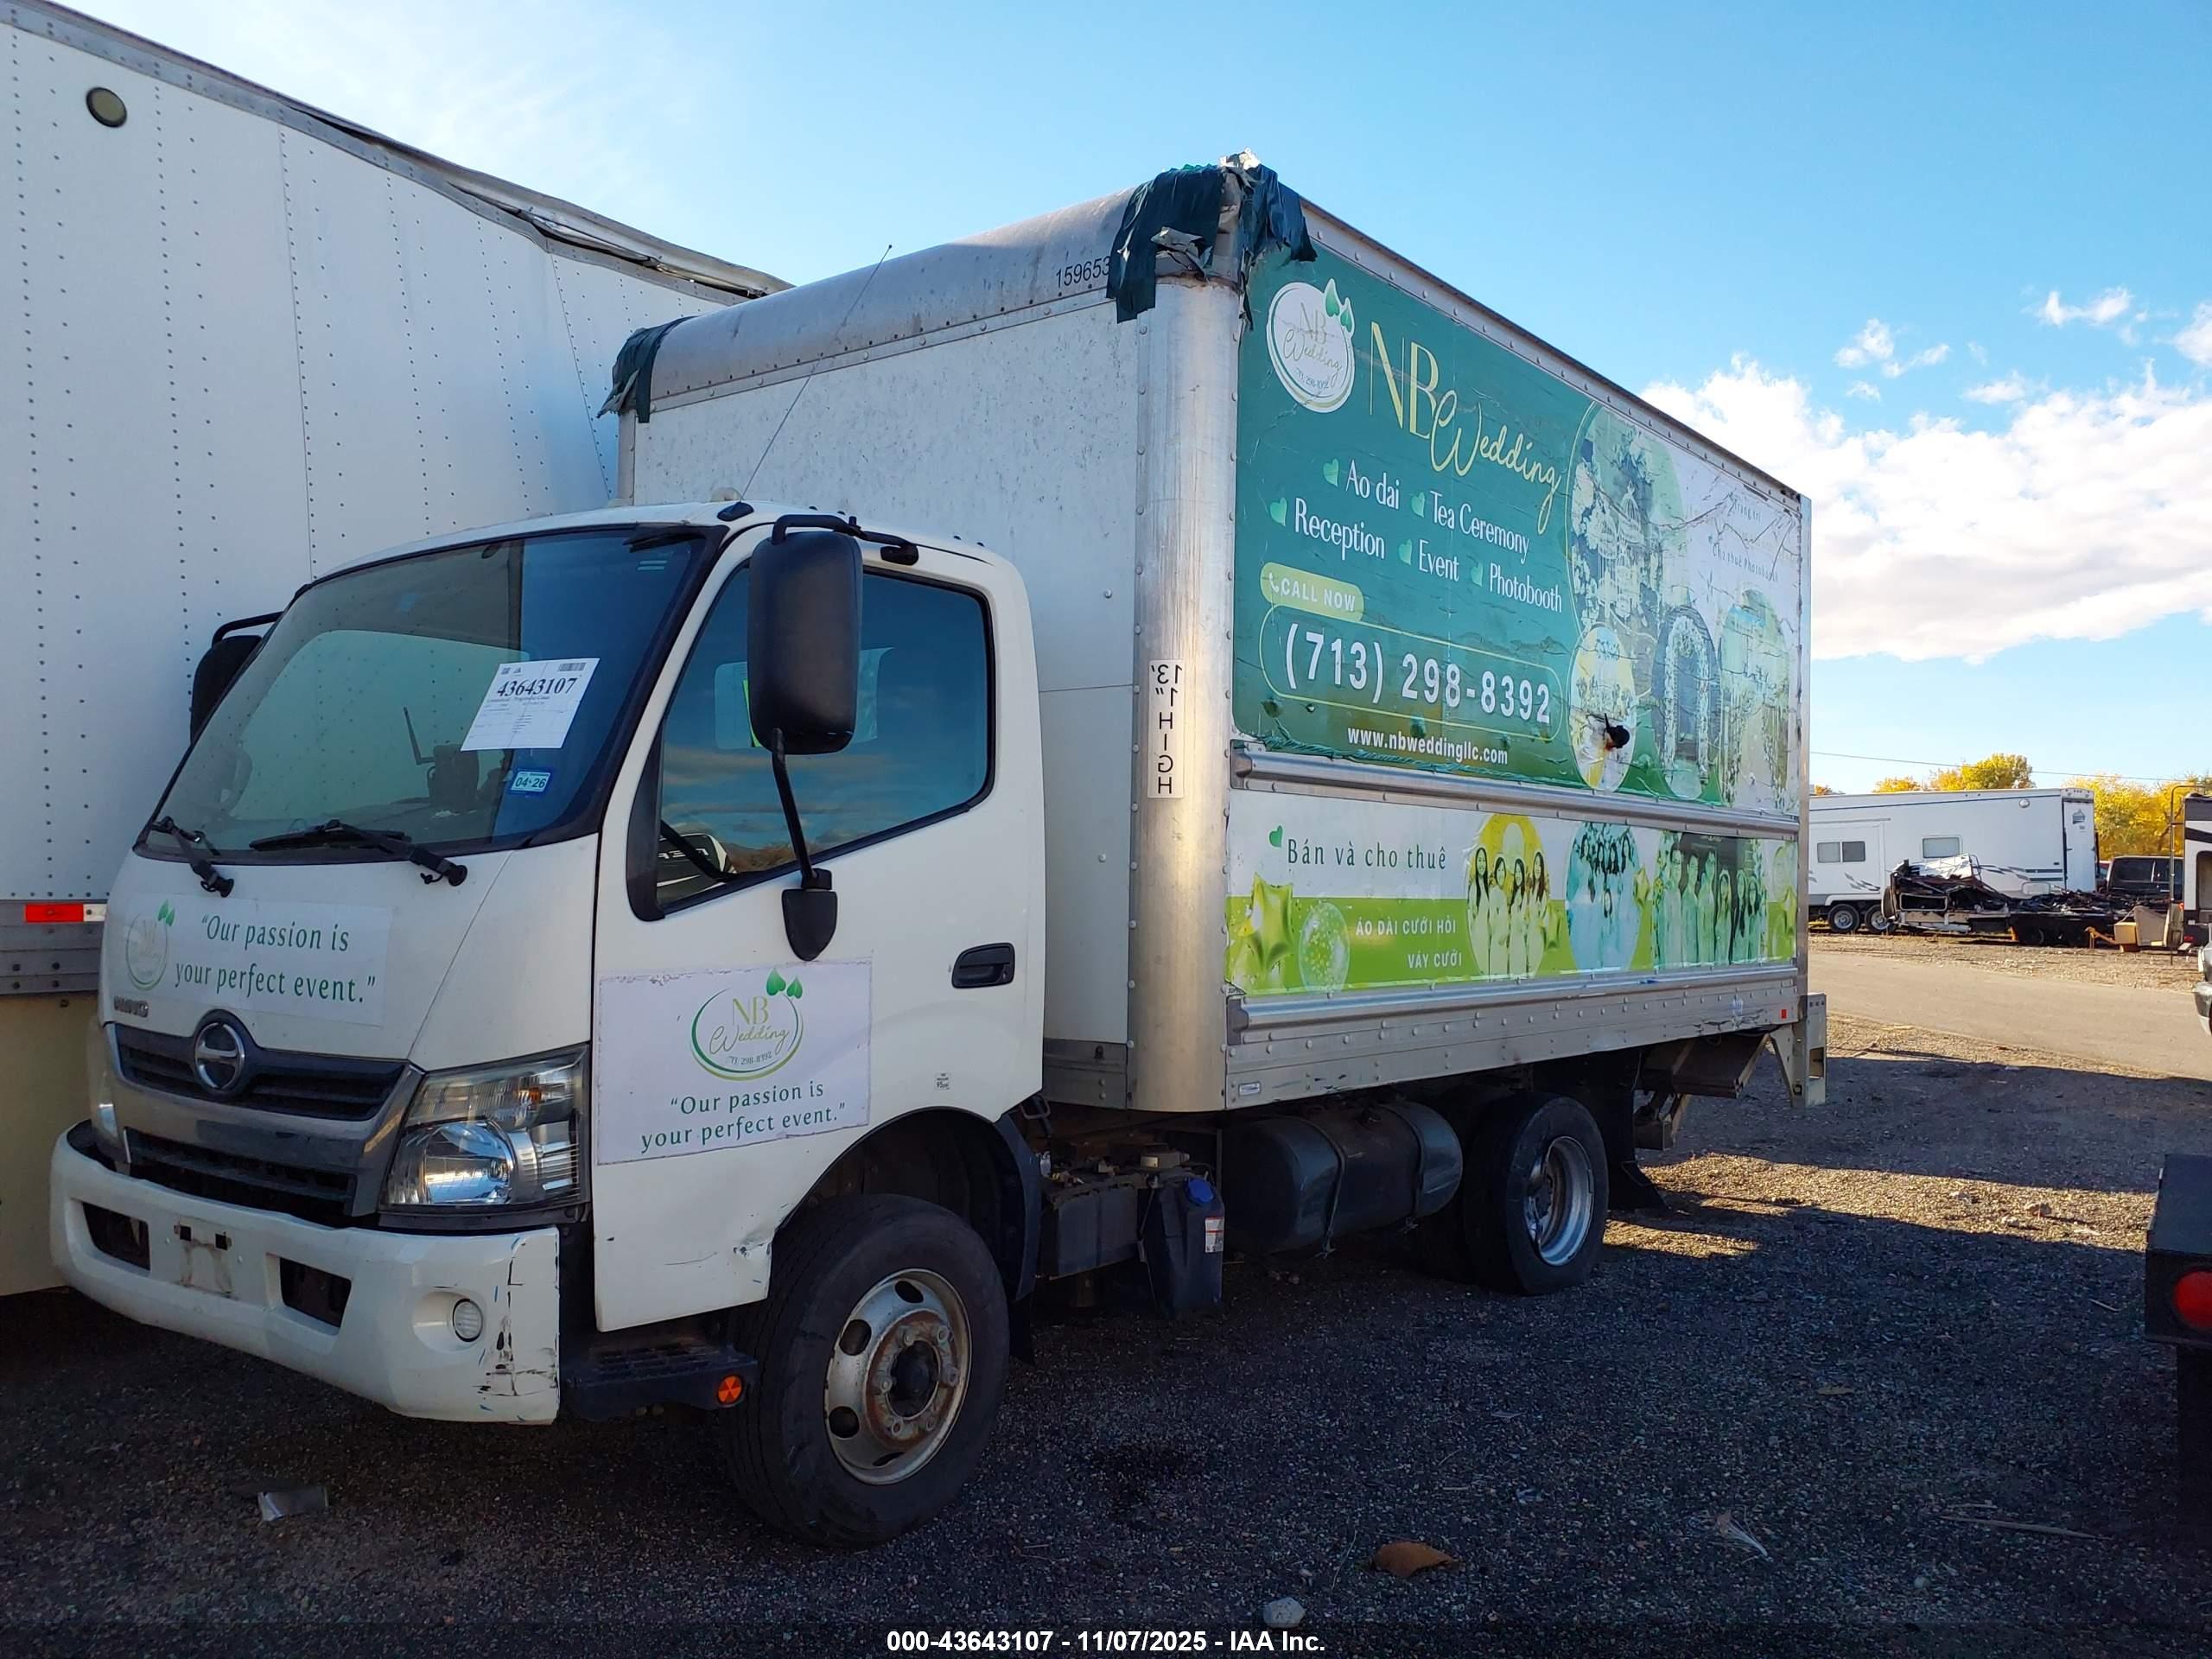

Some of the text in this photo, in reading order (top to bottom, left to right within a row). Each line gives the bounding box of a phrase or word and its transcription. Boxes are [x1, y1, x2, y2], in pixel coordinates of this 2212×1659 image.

[1370, 321, 1440, 439] NB
[1431, 390, 1561, 535] Wedding
[1346, 459, 1529, 564] Ao dai Tea Ceremony
[1295, 498, 1562, 613] Reception Event Photobooth
[1281, 578, 1356, 611] CALL NOW
[497, 677, 578, 697] 43643107
[1286, 623, 1550, 724] (713) 298-8392
[1347, 727, 1509, 766] www.nbweddingllc.com
[1287, 838, 1446, 869] Bán và cho thuê
[245, 921, 321, 950] passion
[331, 924, 350, 951] is
[1356, 916, 1373, 936] ÁO
[175, 961, 212, 988] your
[216, 963, 286, 998] perfect
[732, 995, 770, 1026] NB
[709, 1025, 790, 1055] Wedding
[728, 1084, 802, 1111] passion
[810, 1080, 824, 1098] is
[641, 1128, 692, 1154] your
[701, 1115, 775, 1145] perfect
